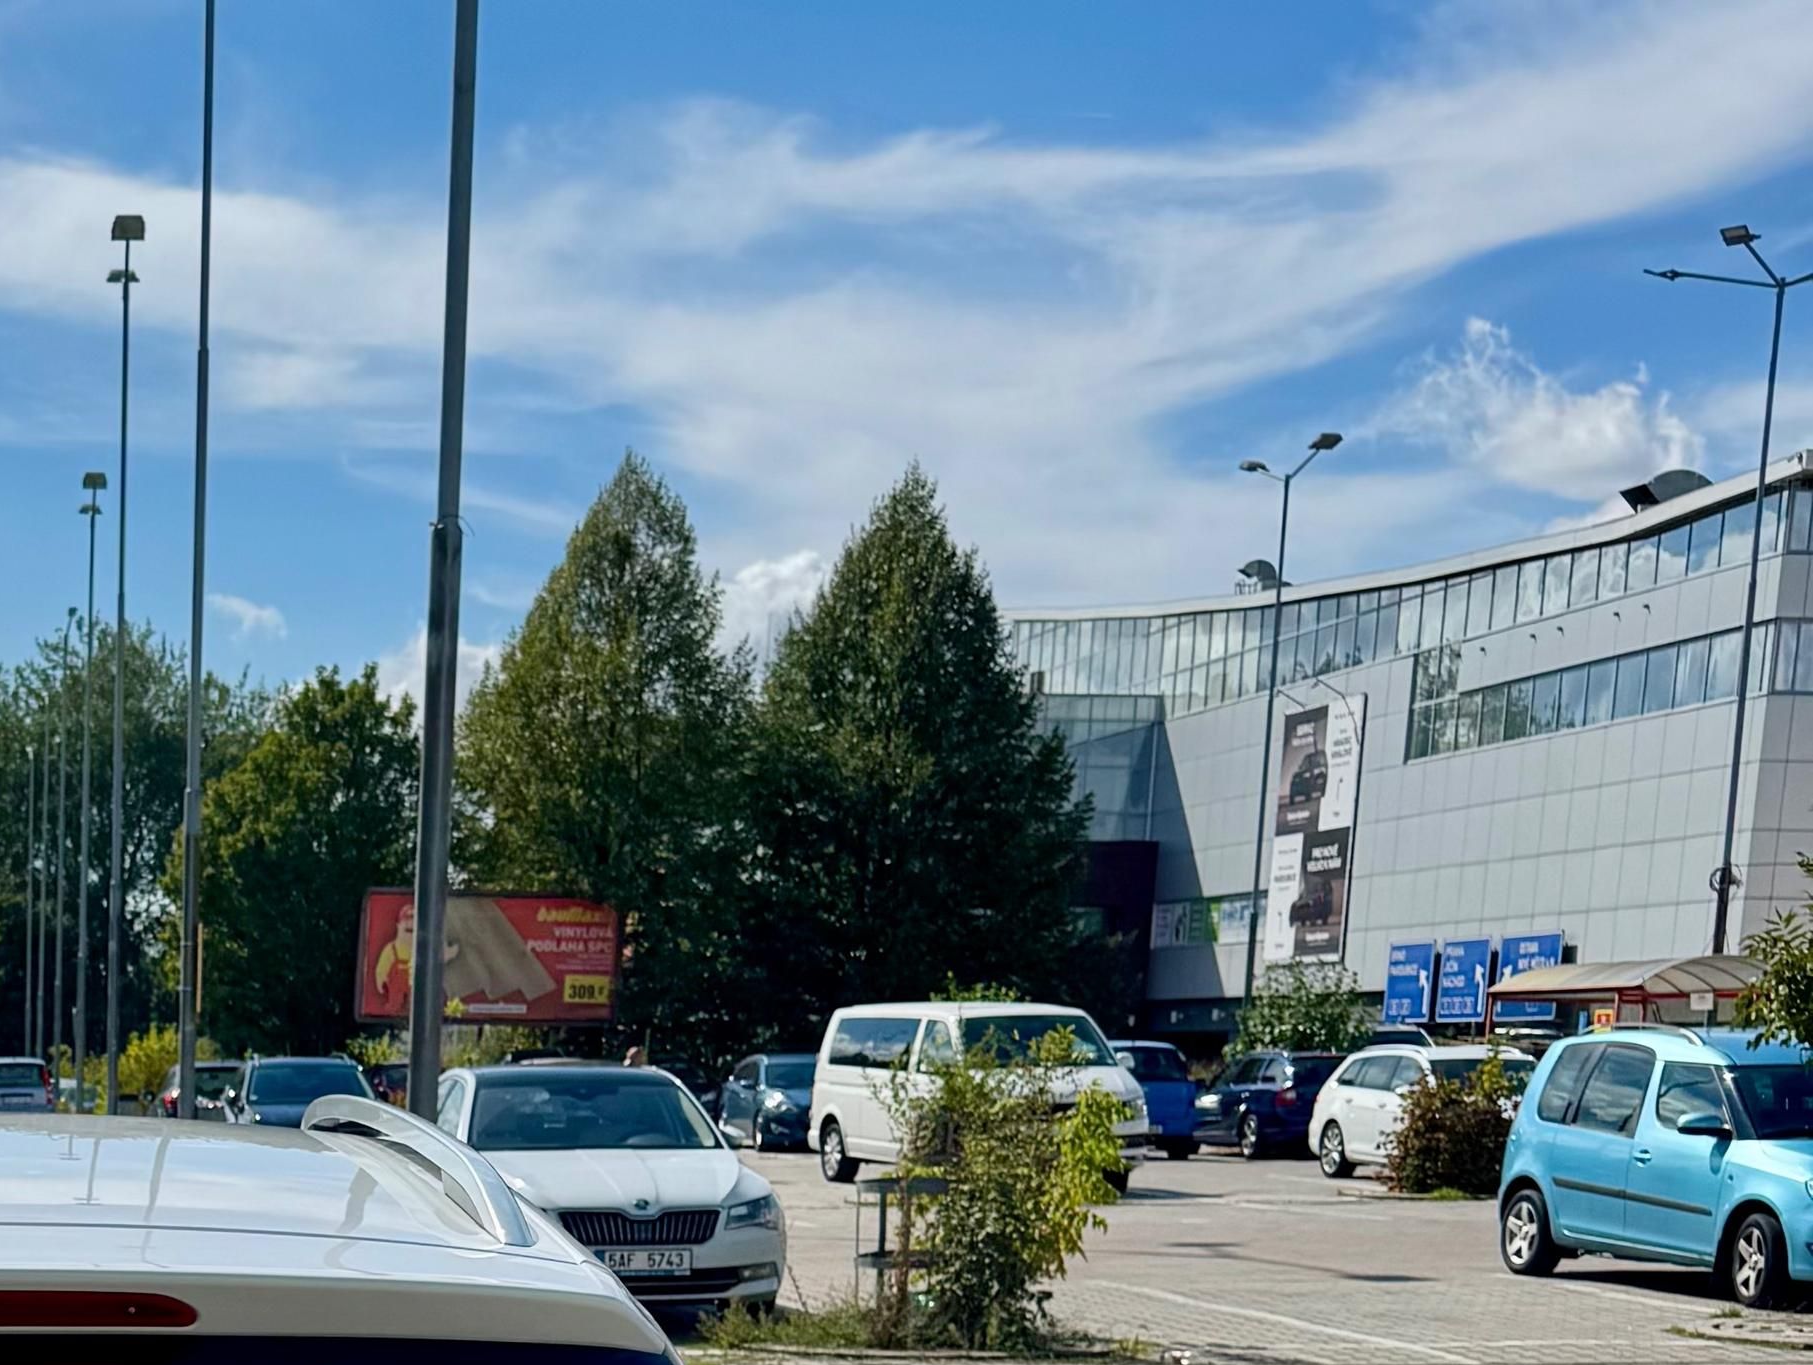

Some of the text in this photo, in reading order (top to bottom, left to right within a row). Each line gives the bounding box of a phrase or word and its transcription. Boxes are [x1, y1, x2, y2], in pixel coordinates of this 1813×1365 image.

[527, 939, 613, 953] PODLAHA SPC
[608, 1252, 684, 1268] 5AF 5743
